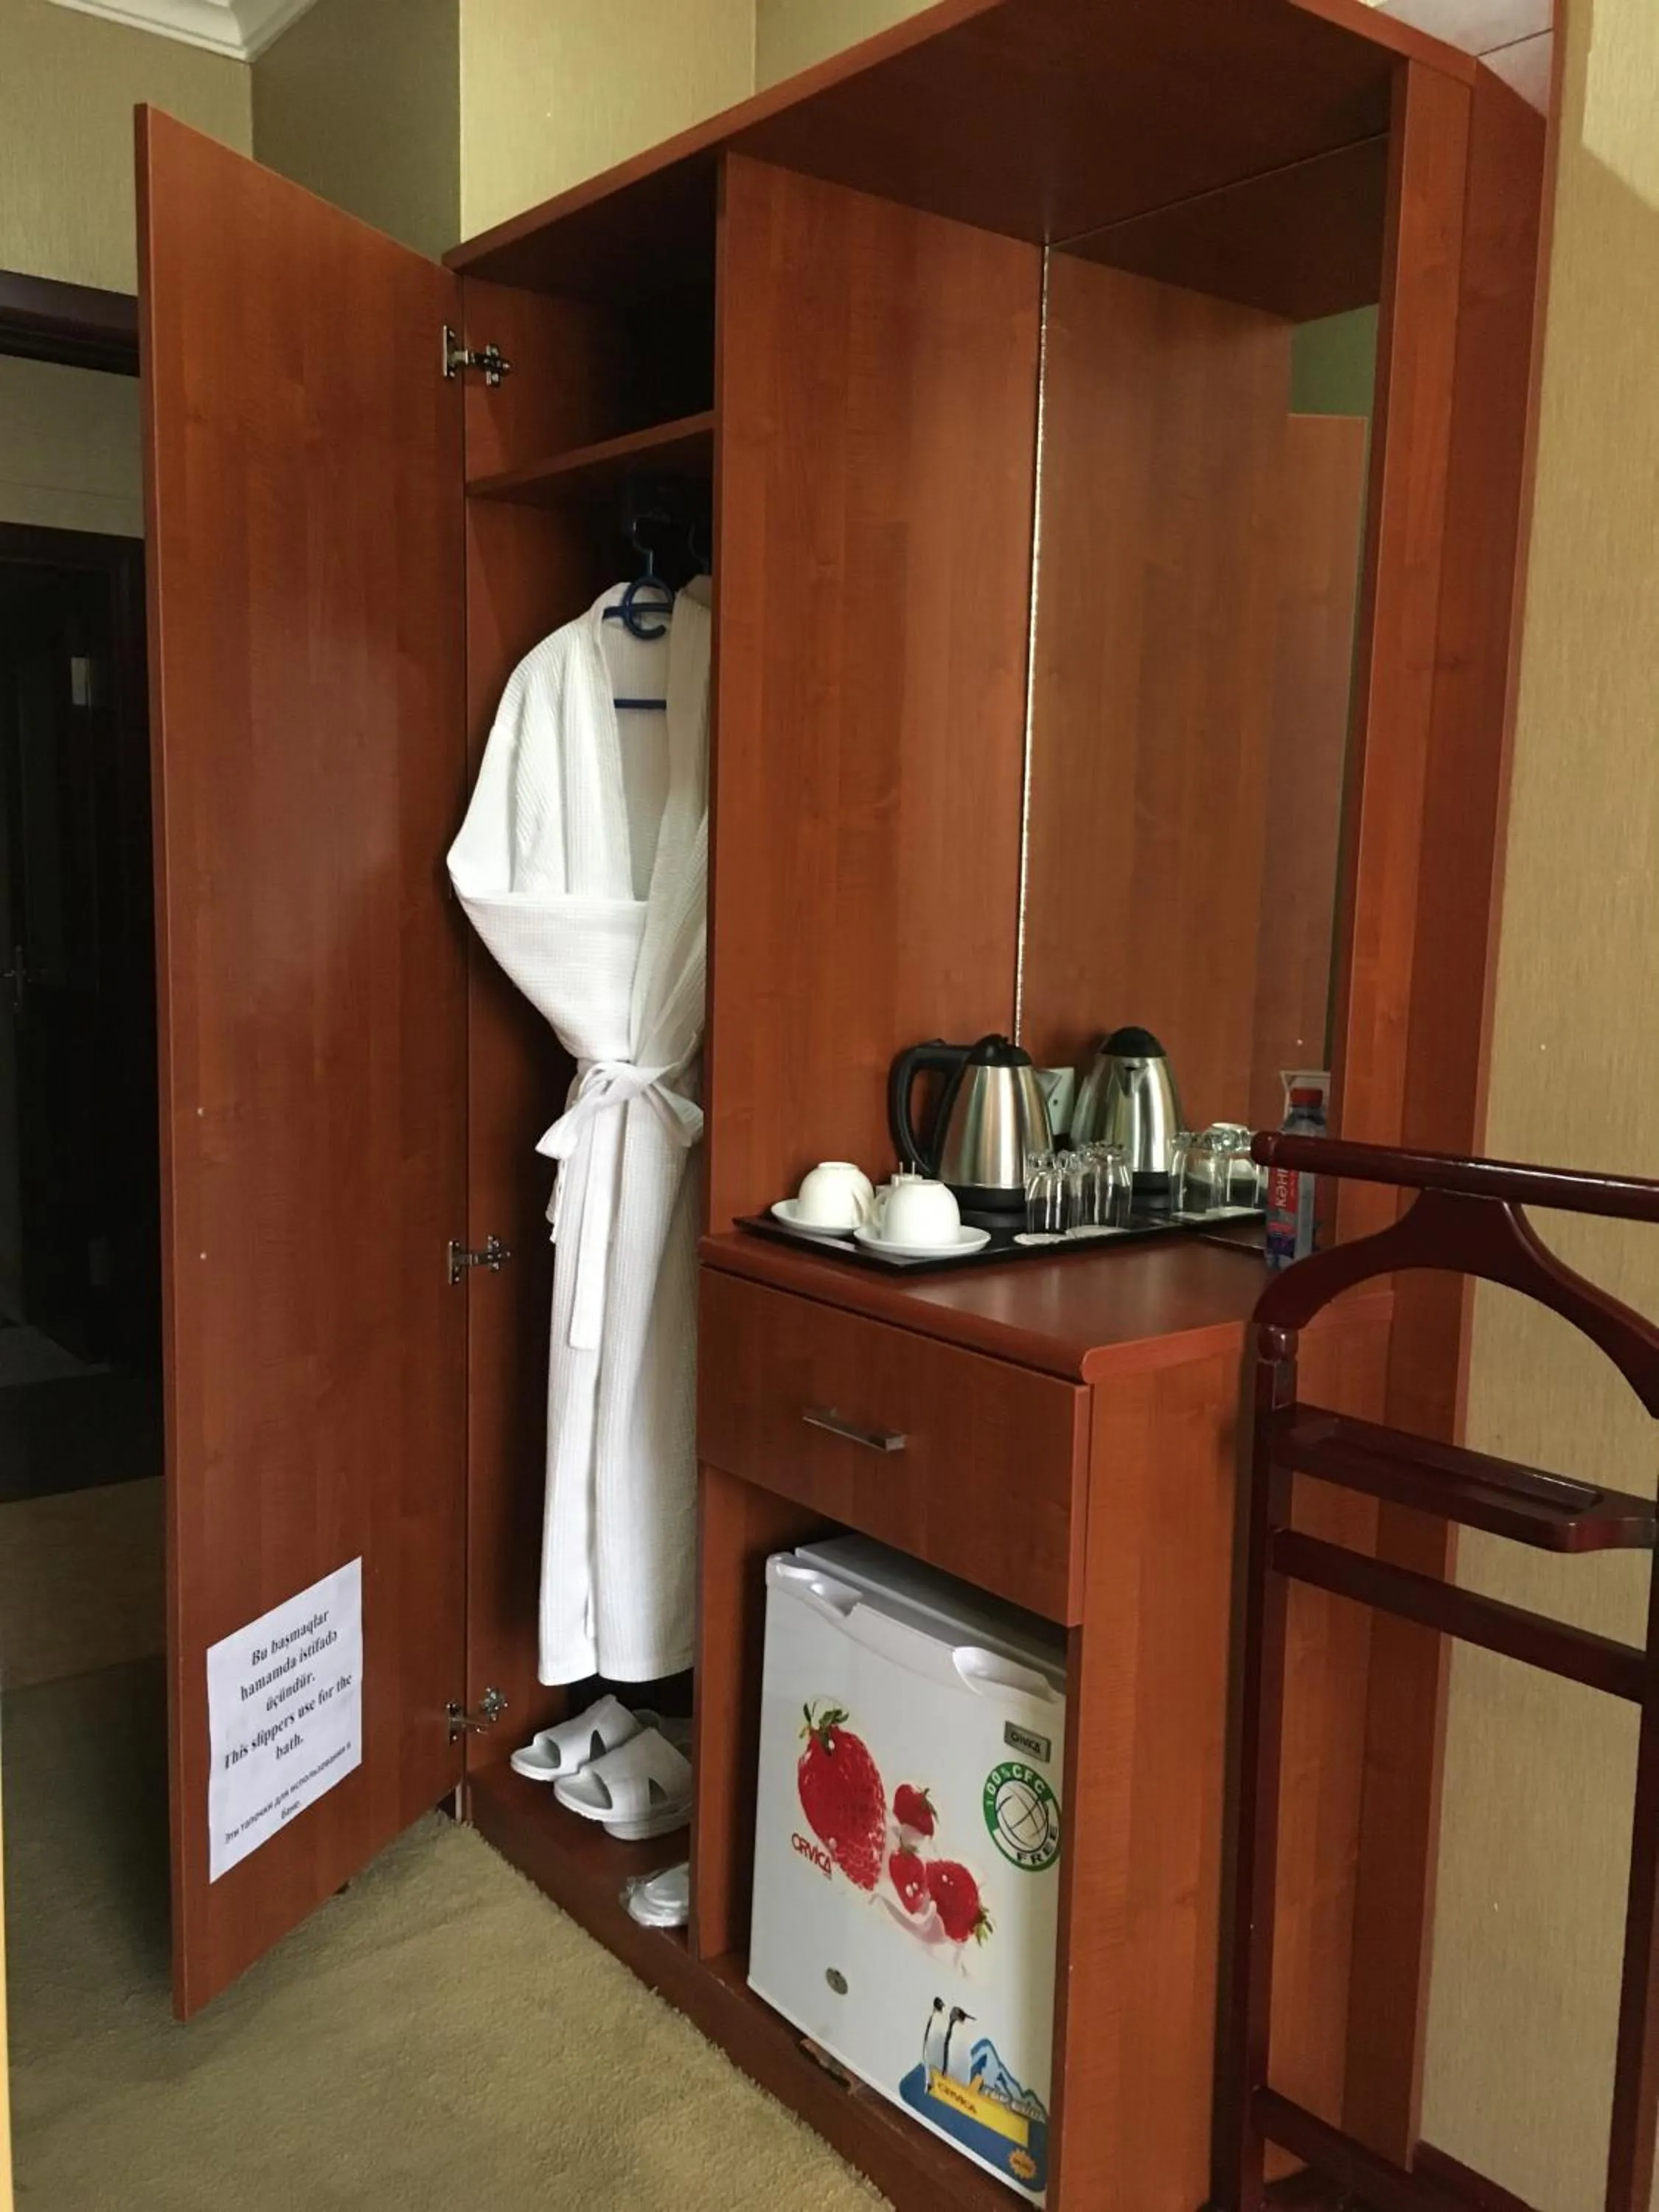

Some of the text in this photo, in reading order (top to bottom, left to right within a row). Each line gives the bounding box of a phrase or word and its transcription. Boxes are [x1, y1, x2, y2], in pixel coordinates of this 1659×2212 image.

[251, 1610, 330, 1666] Bu başmaqlar
[299, 1630, 338, 1663] istifadə
[225, 1674, 352, 1770] This slippers use for the
[275, 1733, 304, 1760] bath.
[1016, 1825, 1058, 1865] FREE
